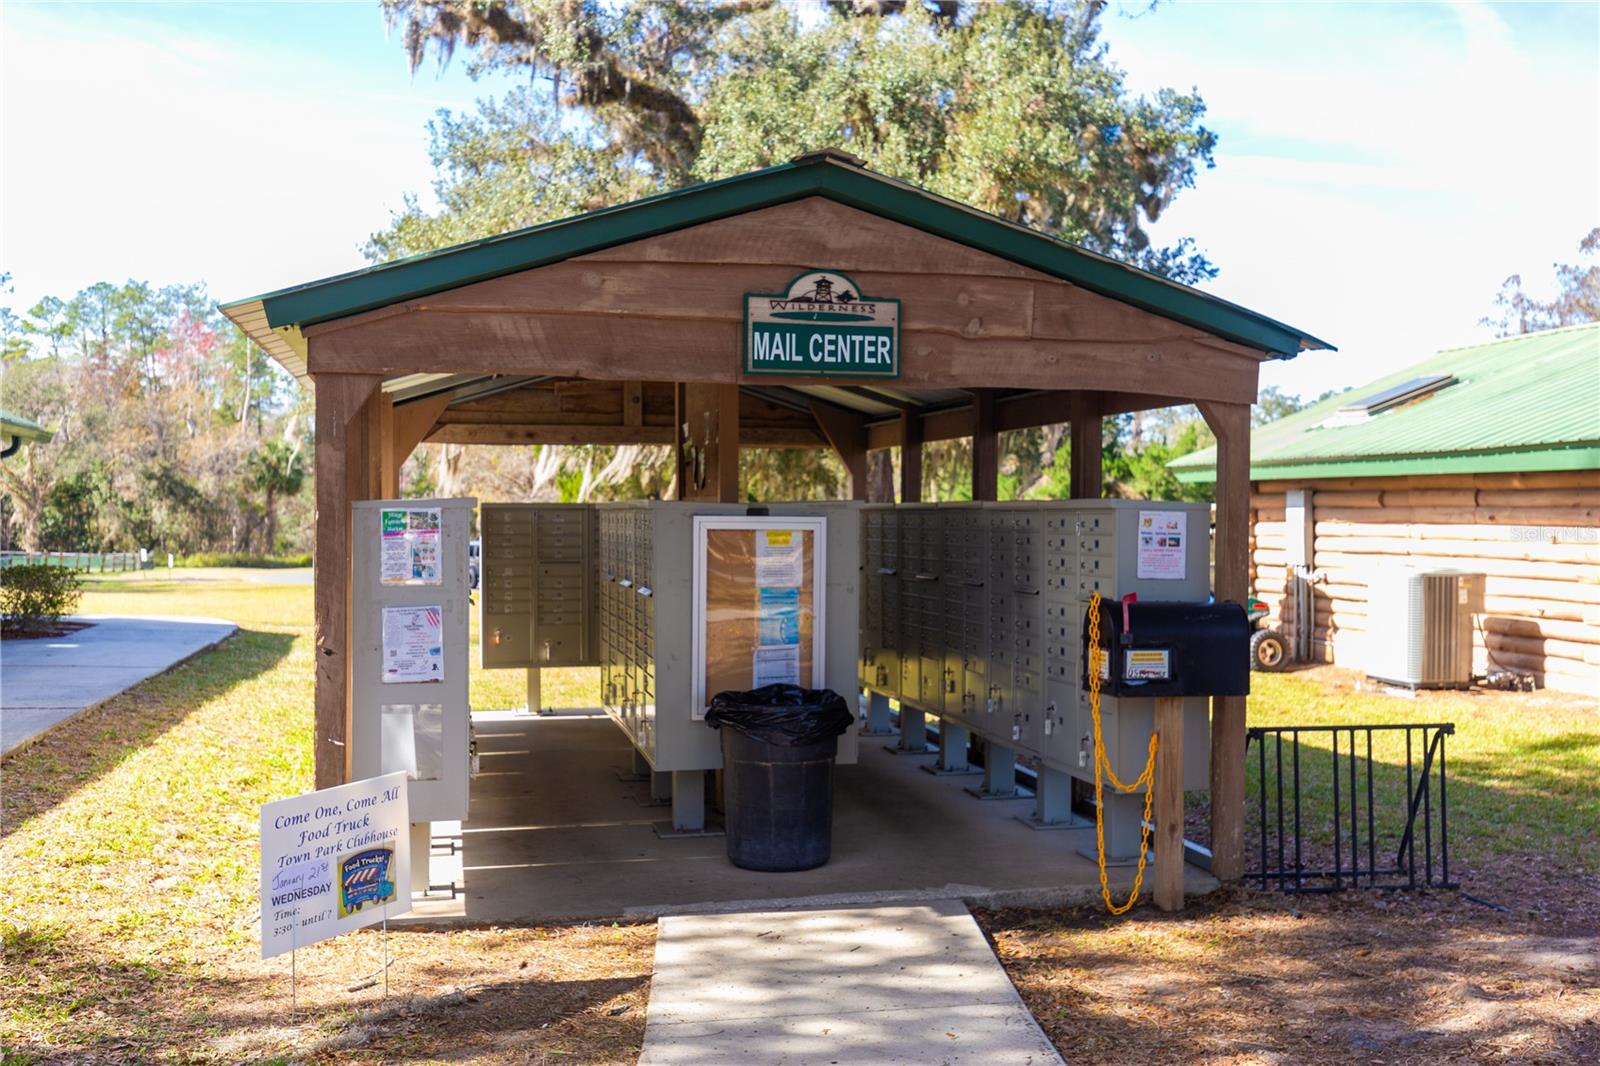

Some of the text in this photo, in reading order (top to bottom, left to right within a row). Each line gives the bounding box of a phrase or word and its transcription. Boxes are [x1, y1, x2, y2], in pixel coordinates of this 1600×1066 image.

[769, 300, 876, 314] WILDERNESS
[754, 332, 891, 364] MAIL CENTER
[274, 786, 401, 830] Come One, Come All
[297, 813, 370, 847] Food Truck
[278, 828, 399, 869] Town Park Clubhouse
[344, 859, 360, 873] Food
[271, 882, 332, 907] WEDNESDAY
[273, 924, 293, 937] 3:30
[302, 910, 326, 927] until
[274, 907, 301, 922] Time:
